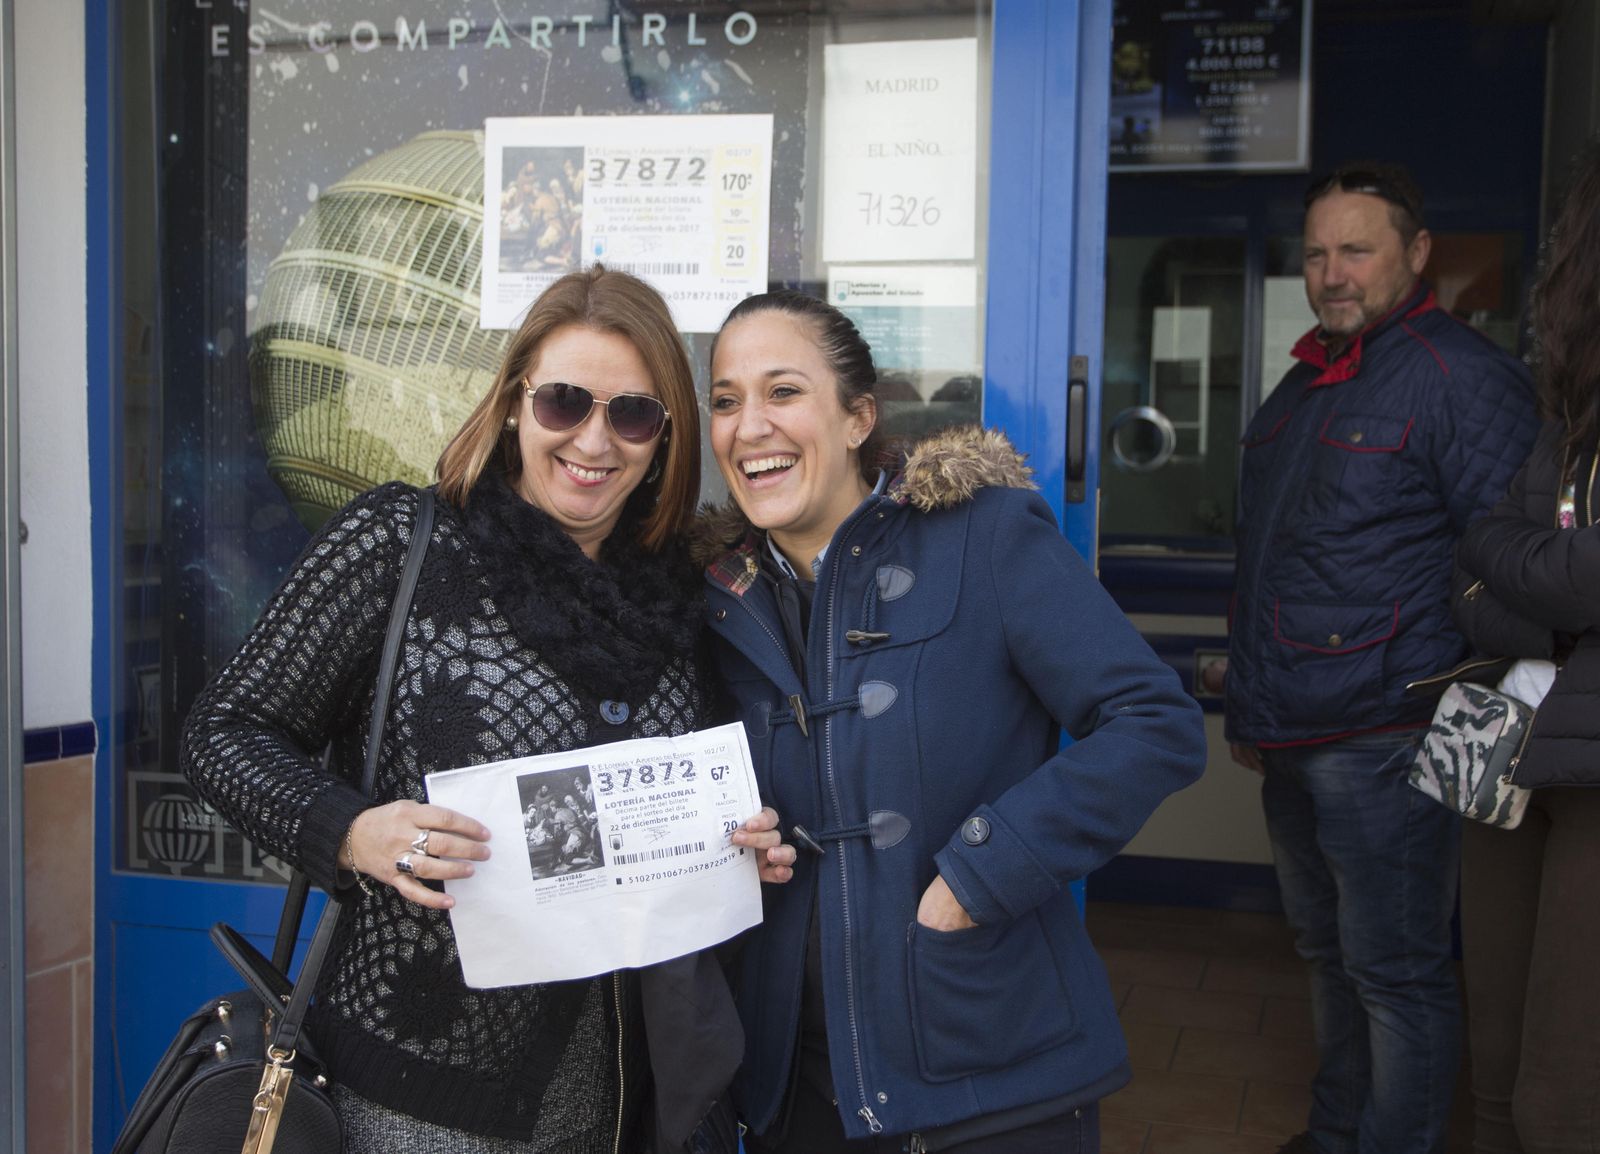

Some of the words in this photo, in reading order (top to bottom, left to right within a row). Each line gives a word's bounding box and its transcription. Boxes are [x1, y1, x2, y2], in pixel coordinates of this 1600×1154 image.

[307, 11, 759, 53] COMPARTIRLO
[865, 77, 939, 94] MADRID
[868, 143, 888, 157] EL
[588, 157, 706, 182] 37872
[593, 195, 641, 204] LOTERÍA
[645, 195, 704, 204] NACIONAL
[856, 192, 941, 227] 71326
[678, 224, 700, 232] 2017
[726, 244, 744, 259] 20
[597, 759, 697, 793] 37872
[605, 797, 645, 810] LOTERÍA
[649, 788, 697, 802] NACIONAL
[640, 803, 656, 812] parte
[669, 797, 689, 806] billete
[621, 814, 634, 822] para
[644, 809, 663, 817] sorteo
[621, 822, 631, 830] de
[633, 815, 669, 828] diciembre
[681, 810, 698, 820] 2017
[723, 820, 738, 833] 20
